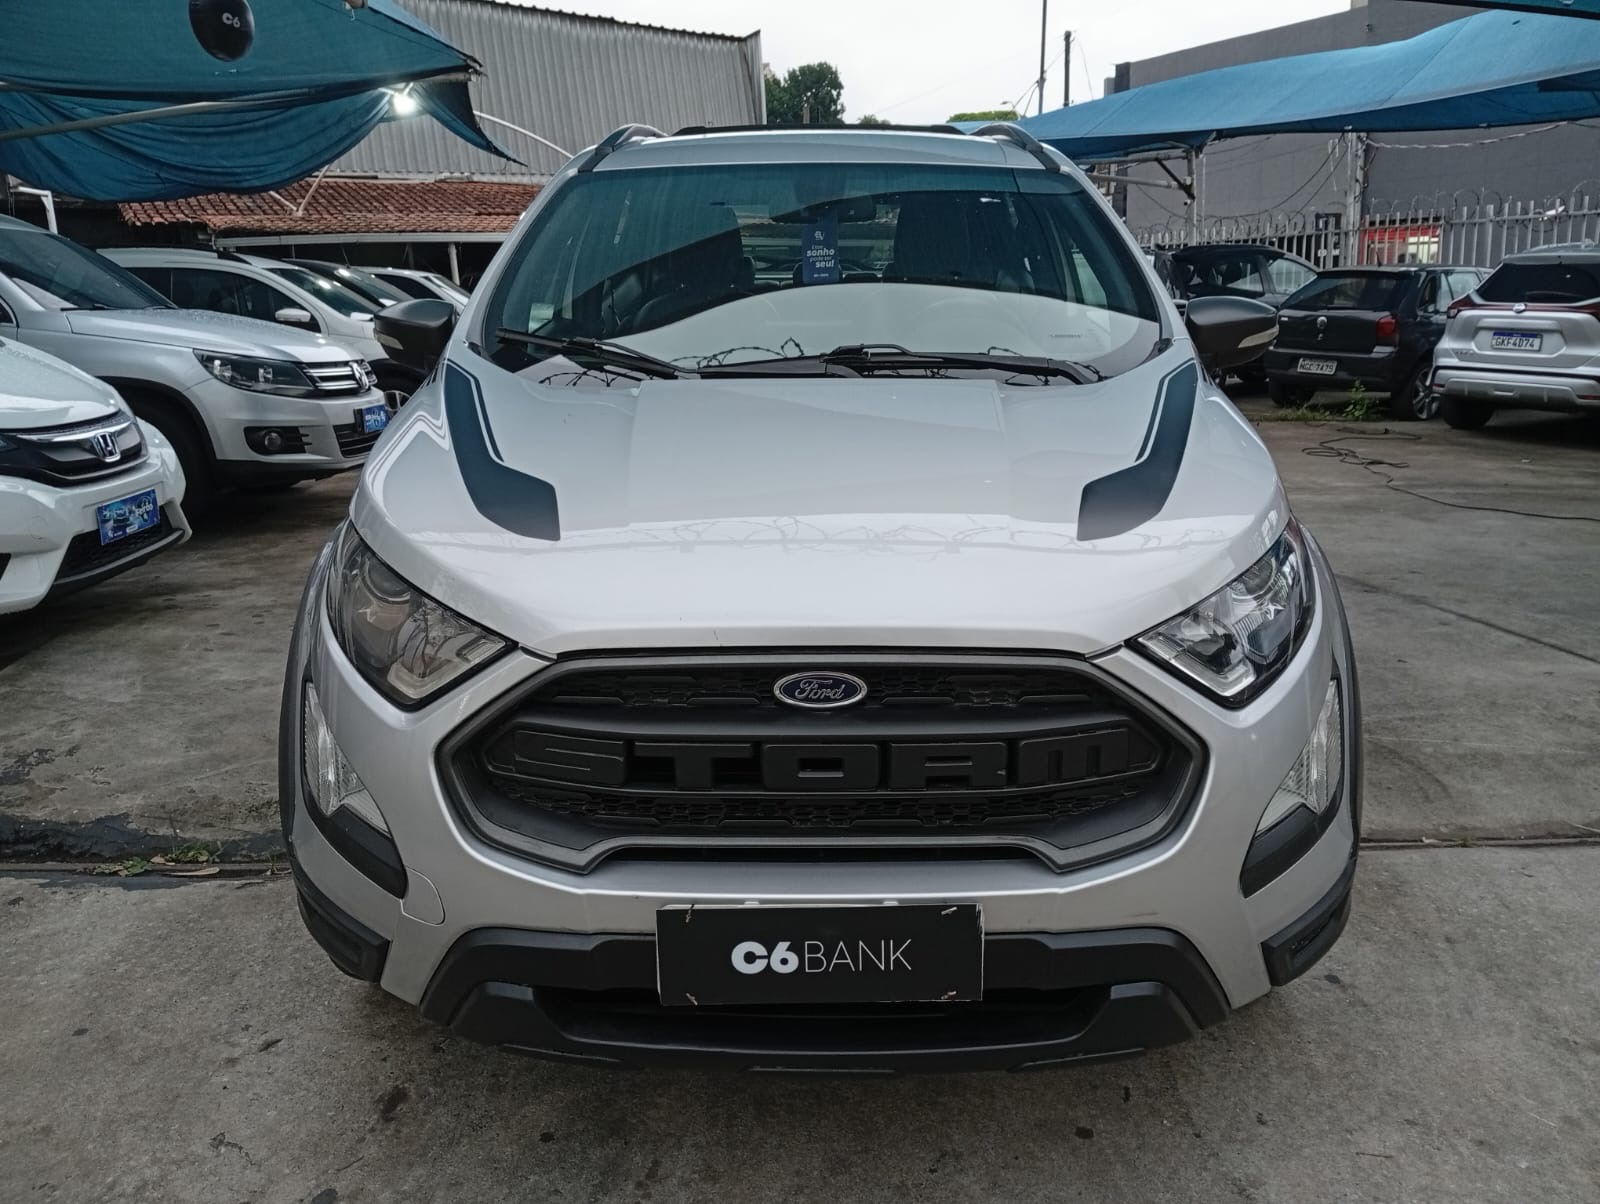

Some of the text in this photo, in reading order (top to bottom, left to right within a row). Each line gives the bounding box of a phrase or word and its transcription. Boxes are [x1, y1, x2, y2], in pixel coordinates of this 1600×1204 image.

[222, 12, 241, 28] C6
[806, 247, 835, 257] sonho
[1495, 336, 1535, 348] GKF4D74
[795, 679, 846, 699] Ford
[513, 728, 1129, 790] STORM
